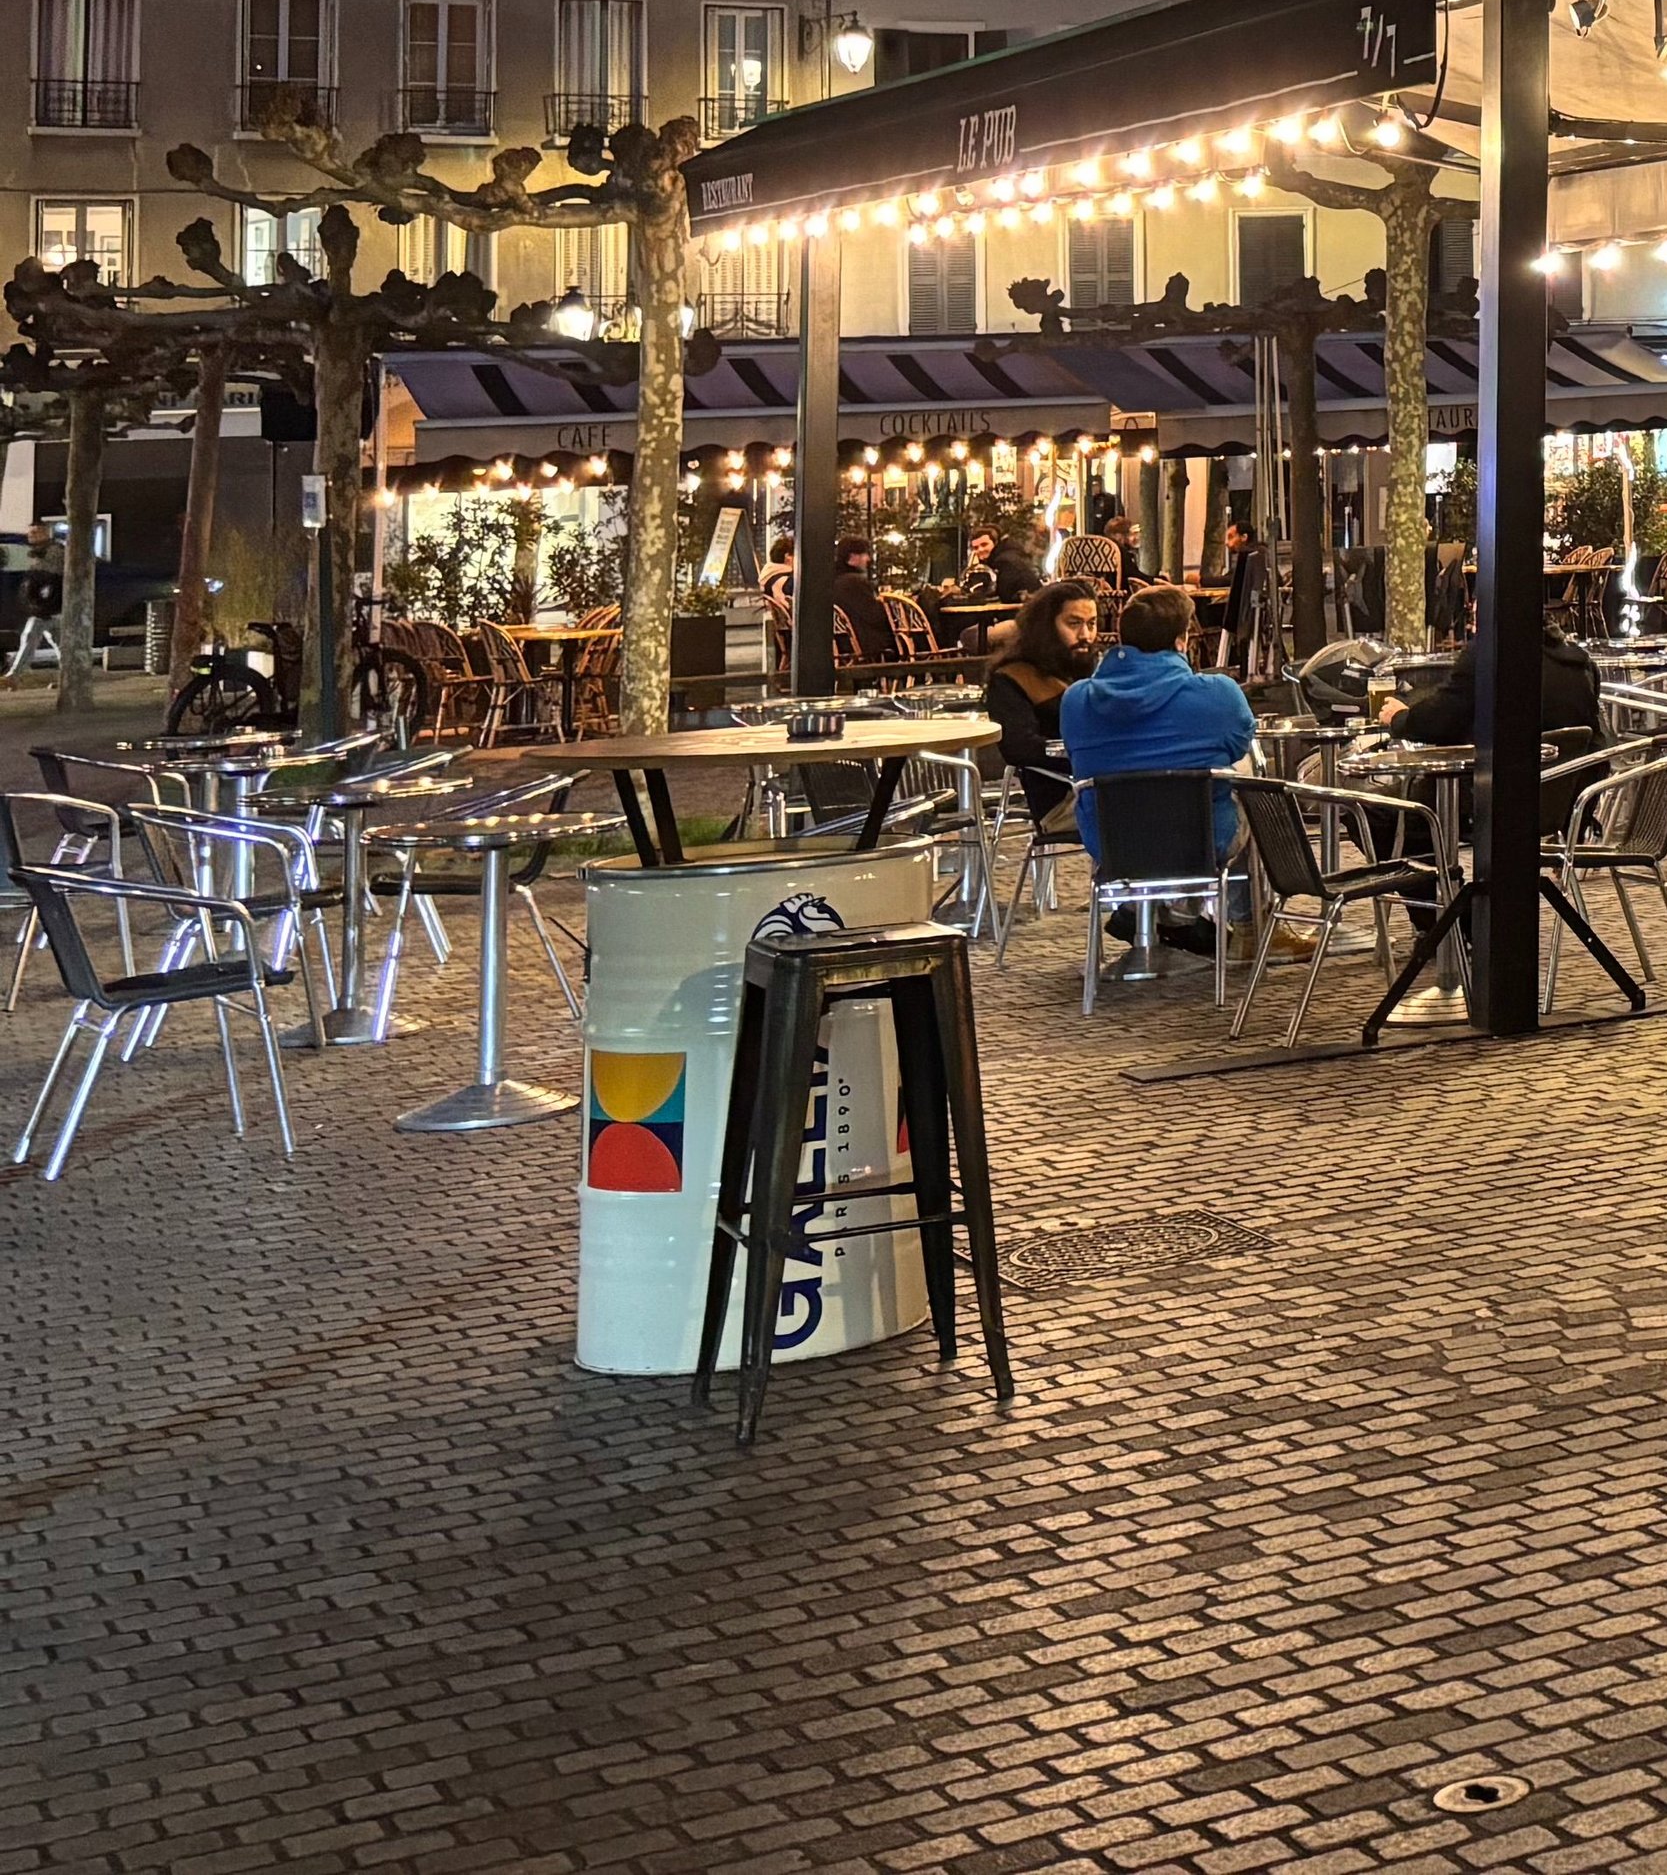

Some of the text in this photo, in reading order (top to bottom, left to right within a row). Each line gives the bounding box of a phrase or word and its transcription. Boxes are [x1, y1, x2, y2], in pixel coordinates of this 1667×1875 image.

[957, 104, 1017, 174] LE PUB
[879, 410, 991, 437] COCKTAILS
[1428, 407, 1478, 429] TAUR
[834, 1173, 849, 1257] PRS
